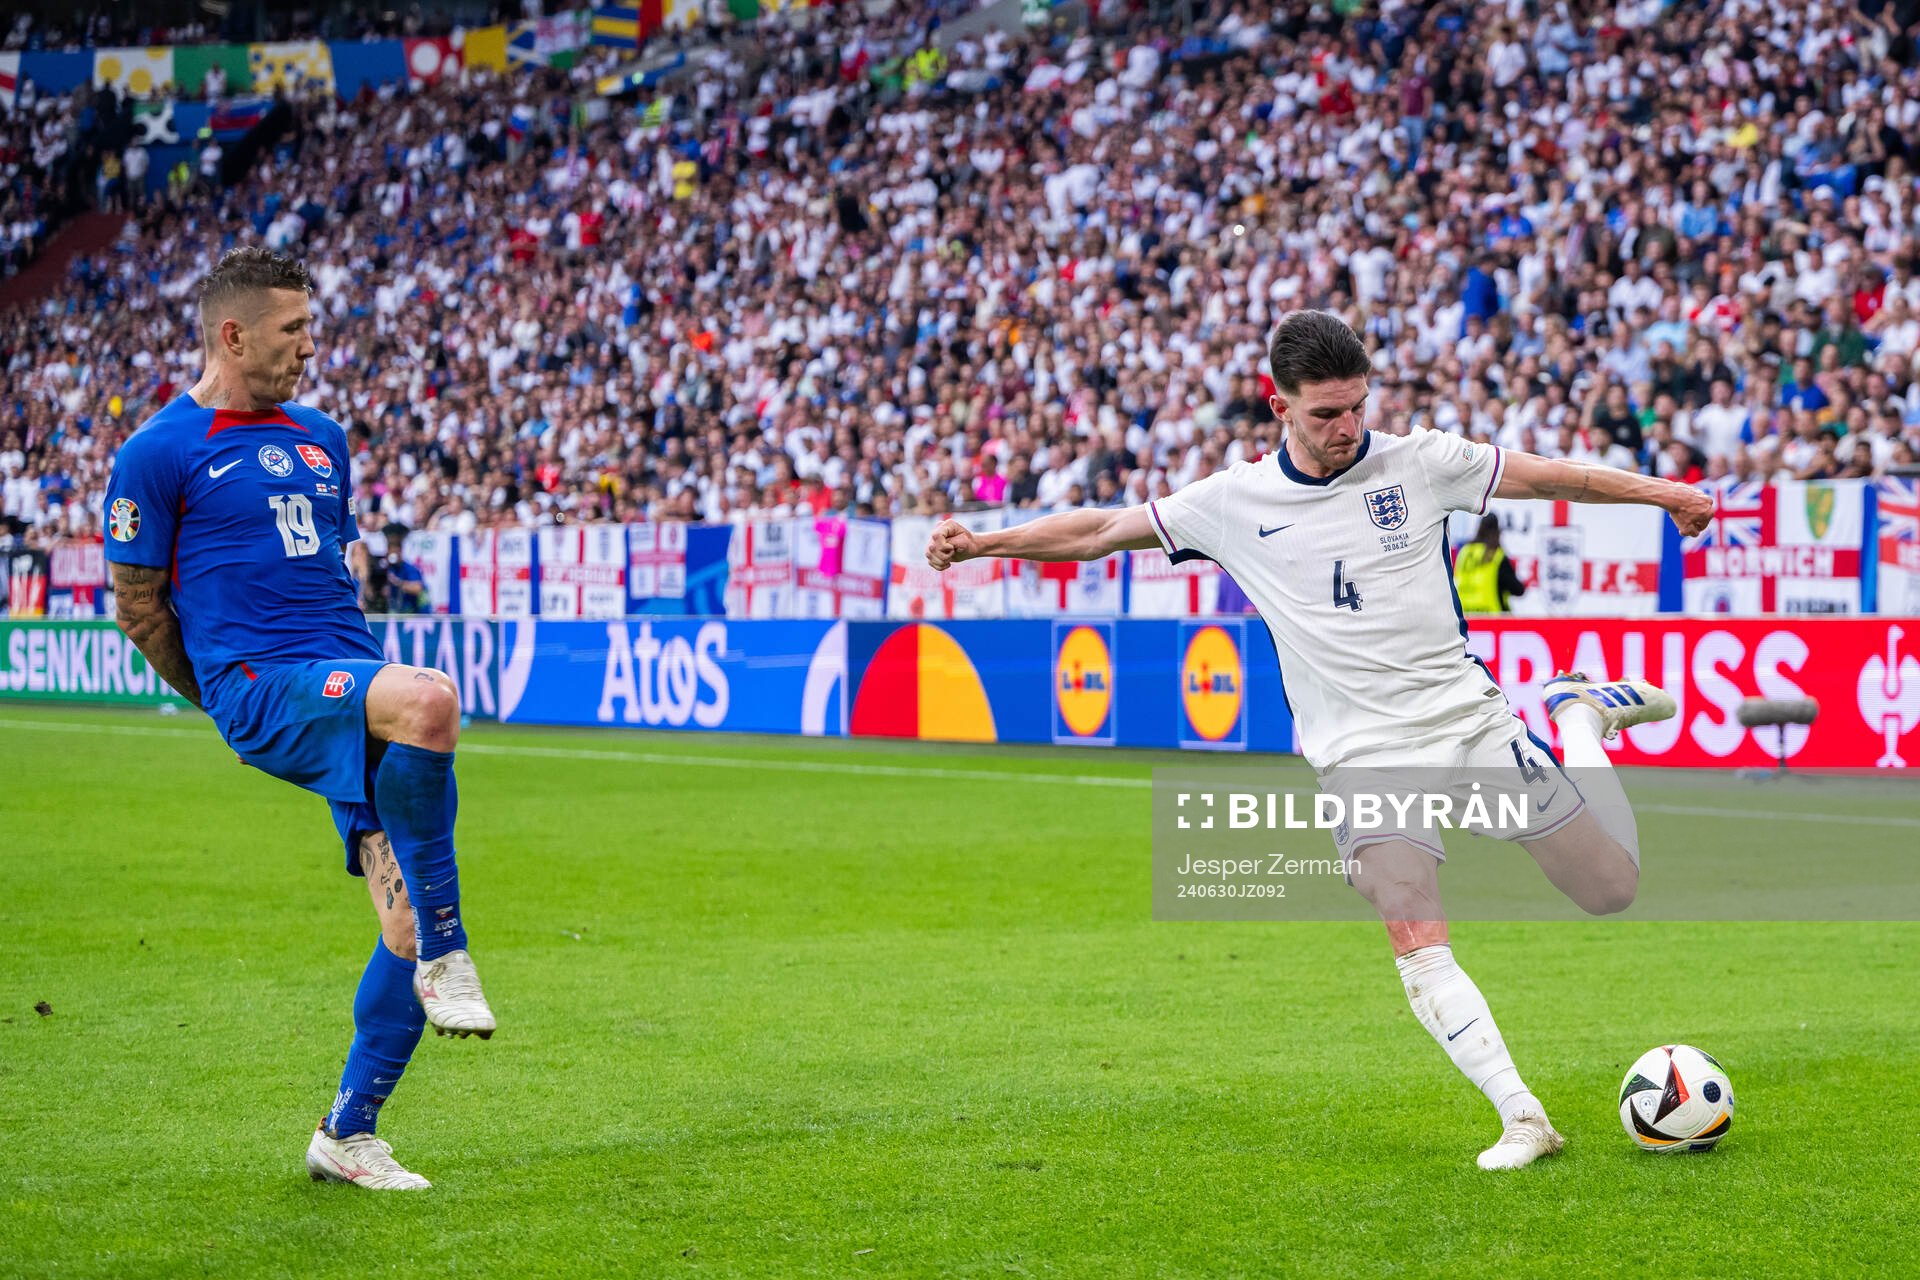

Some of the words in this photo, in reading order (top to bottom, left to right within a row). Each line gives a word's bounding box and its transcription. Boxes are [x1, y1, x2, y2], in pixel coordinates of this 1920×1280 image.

[268, 493, 320, 557] 19
[1380, 533, 1409, 544] SLOVAKIA
[1333, 560, 1363, 612] 4
[1706, 546, 1834, 577] NORWICH
[597, 621, 730, 728] Atos
[1510, 739, 1550, 785] 4
